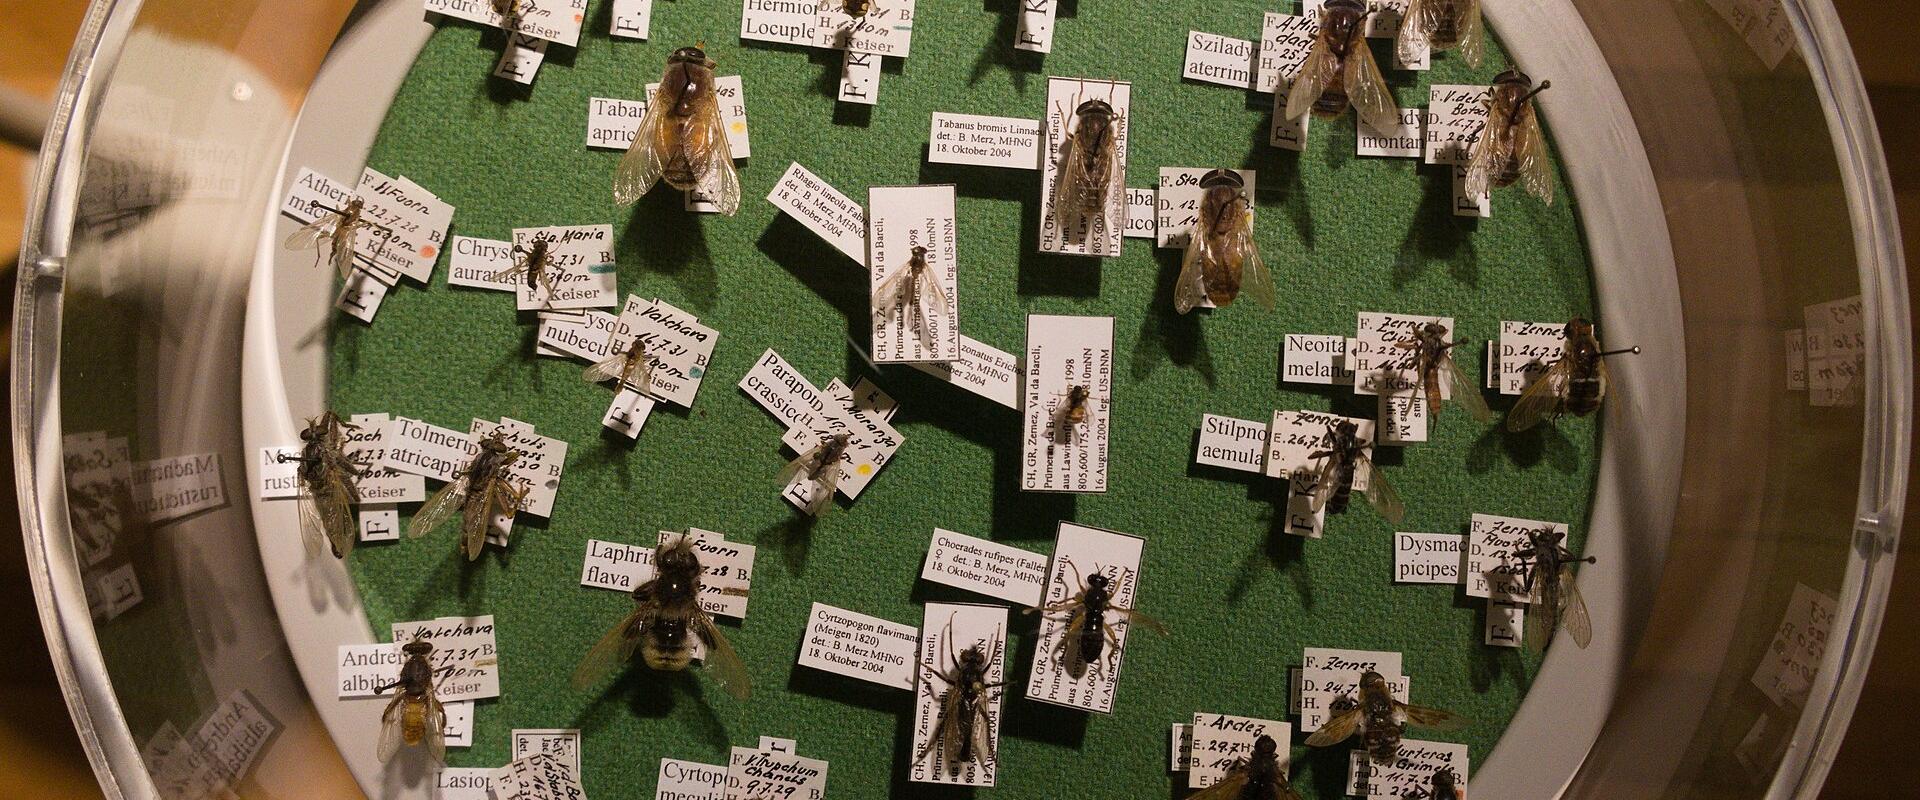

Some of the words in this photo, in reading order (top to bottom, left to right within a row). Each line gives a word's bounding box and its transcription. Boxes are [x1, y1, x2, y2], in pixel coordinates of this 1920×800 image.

[511, 17, 561, 40] Keiser
[845, 37, 894, 54] Keiser
[938, 119, 975, 131] Tabanus
[977, 121, 1008, 133] bromis
[935, 143, 950, 154] 18.
[952, 145, 988, 157] Oktober
[990, 148, 1013, 159] 2004
[971, 135, 996, 147] Merz,
[999, 137, 1033, 148] MHNG
[791, 167, 821, 192] Rhagio
[1046, 176, 1059, 209] Zernez,
[777, 188, 790, 203] 18.
[790, 197, 823, 225] Oktober
[821, 219, 844, 239] 2004
[813, 197, 835, 220] Merz,
[873, 217, 886, 248] Barcli,
[942, 217, 955, 262] US-BNM
[1043, 236, 1055, 251] CH,
[366, 239, 413, 270] Keiser
[599, 251, 616, 264] B.
[874, 264, 884, 281] Val
[551, 288, 601, 303] Keiser
[945, 286, 955, 311] 2004
[876, 319, 888, 339] GR,
[1503, 321, 1517, 334] F.
[877, 341, 889, 361] CH,
[913, 347, 922, 361] aus
[960, 343, 993, 364] zonatus
[1031, 344, 1044, 376] Barcli,
[1503, 344, 1518, 357] D.
[975, 364, 1010, 385] MHNG
[1065, 357, 1075, 381] 1998
[1098, 348, 1111, 393] US-BNM
[1357, 359, 1374, 371] H.
[963, 370, 987, 387] 2004
[1509, 379, 1523, 392] F.
[1029, 391, 1040, 409] Val
[1027, 411, 1041, 443] Zernez,
[1096, 417, 1108, 443] 2004
[1027, 445, 1039, 468] GR,
[1201, 444, 1265, 467] aemula
[1272, 450, 1286, 462] B.
[1026, 469, 1038, 490] CH,
[1062, 474, 1071, 490] aus
[357, 486, 407, 500] Keiser
[1472, 521, 1486, 534] F.
[936, 536, 984, 558] Choerades
[983, 549, 1016, 566] rufipes
[1471, 544, 1486, 556] D.
[586, 565, 631, 589] flava
[735, 567, 751, 583] B.
[931, 560, 944, 574] 18.
[946, 564, 984, 583] Oktober
[982, 574, 1007, 590] 2004
[973, 558, 984, 570] B.
[985, 562, 1012, 579] Merz,
[1012, 569, 1049, 588] MHNG
[1400, 560, 1458, 581] picipes
[1469, 561, 1485, 574] H.
[1475, 579, 1489, 592] F.
[394, 629, 409, 643] F.
[814, 622, 852, 641] (Meigen
[854, 632, 881, 648] 1820)
[1039, 620, 1057, 654] Zernez,
[808, 646, 822, 660] 18.
[823, 651, 861, 669] Oktober
[861, 660, 886, 676] 2004
[810, 635, 832, 649] det.:
[832, 640, 843, 652] B.
[845, 643, 869, 658] Merz
[869, 649, 905, 667] MHNG
[1036, 655, 1048, 675] GR,
[1305, 655, 1319, 670] F.
[1031, 675, 1046, 698] CH,
[1303, 679, 1319, 692] D.
[1067, 688, 1077, 706] aus
[1302, 696, 1320, 710] H.
[918, 700, 933, 737] Zernez,
[1194, 714, 1207, 727] F.
[1192, 739, 1206, 751] E.
[1191, 757, 1205, 770] B.
[727, 775, 743, 790] D.
